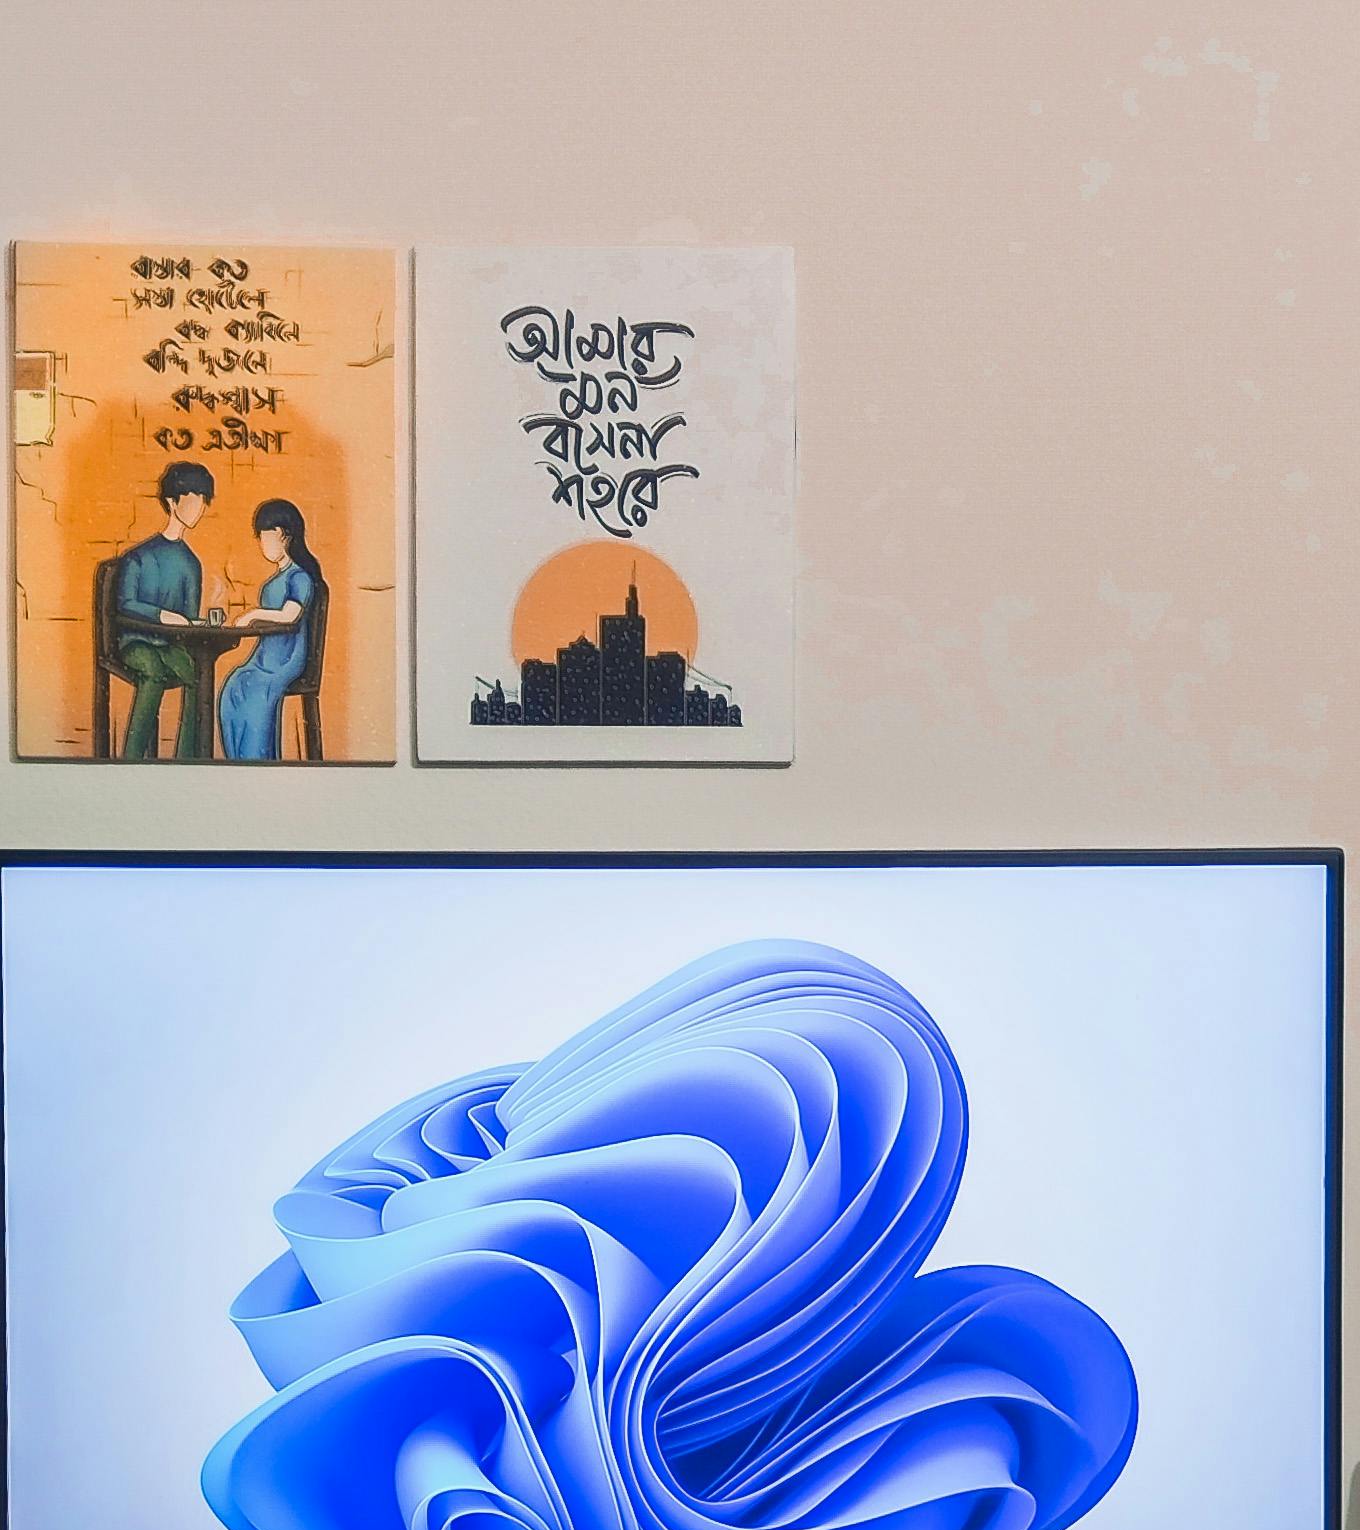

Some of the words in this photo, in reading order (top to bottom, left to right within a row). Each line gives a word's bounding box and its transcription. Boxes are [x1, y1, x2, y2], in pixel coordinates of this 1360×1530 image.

[500, 304, 696, 391] আমার
[536, 361, 639, 421] মন
[534, 461, 701, 539] শহরে
